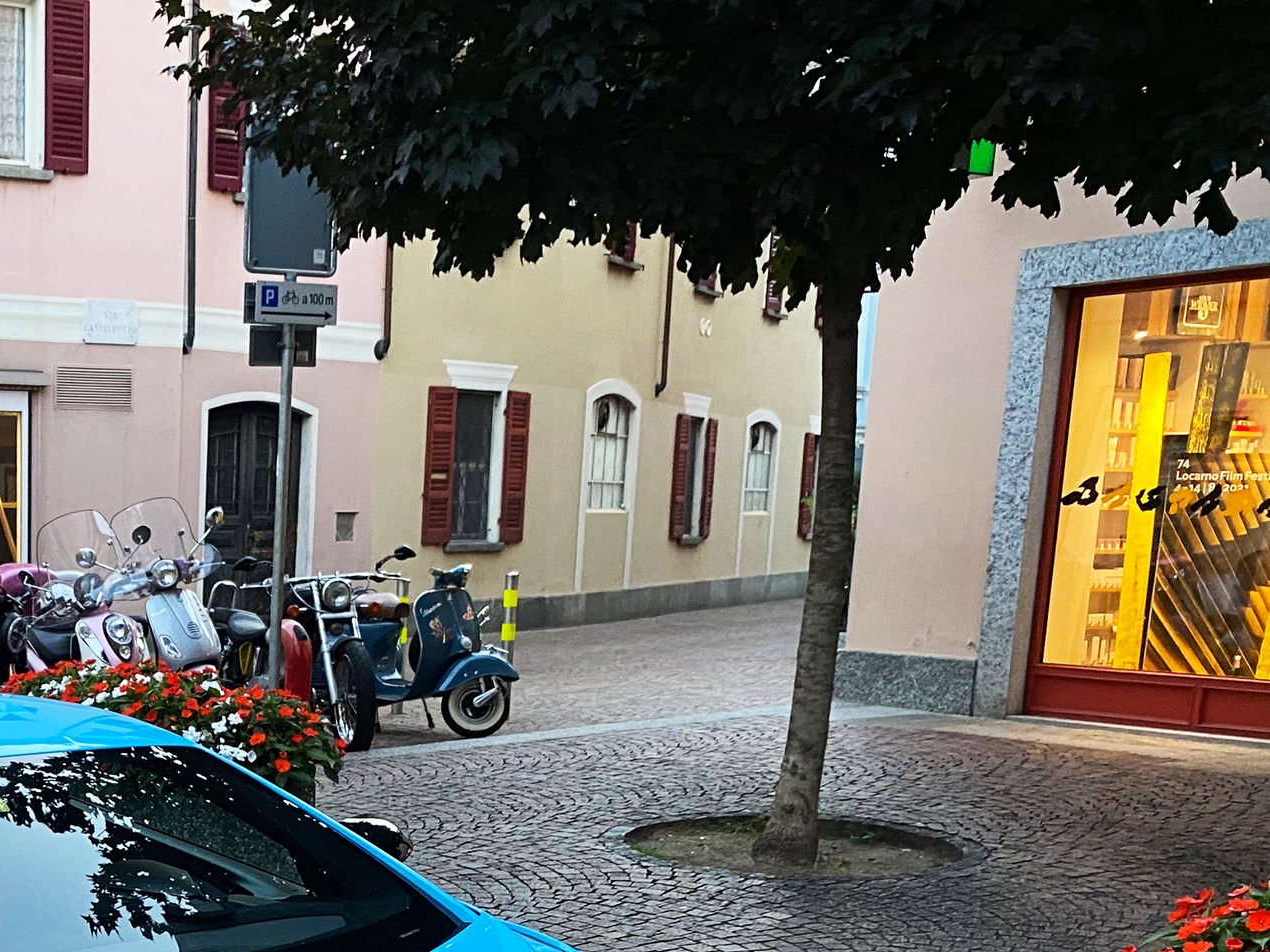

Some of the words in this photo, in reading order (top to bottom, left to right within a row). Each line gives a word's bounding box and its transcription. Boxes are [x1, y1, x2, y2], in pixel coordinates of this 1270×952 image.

[266, 289, 275, 305] P
[309, 293, 324, 305] 100
[325, 296, 334, 306] m
[1177, 459, 1190, 469] 74
[1176, 471, 1218, 481] Locarno
[1220, 470, 1243, 481] Film
